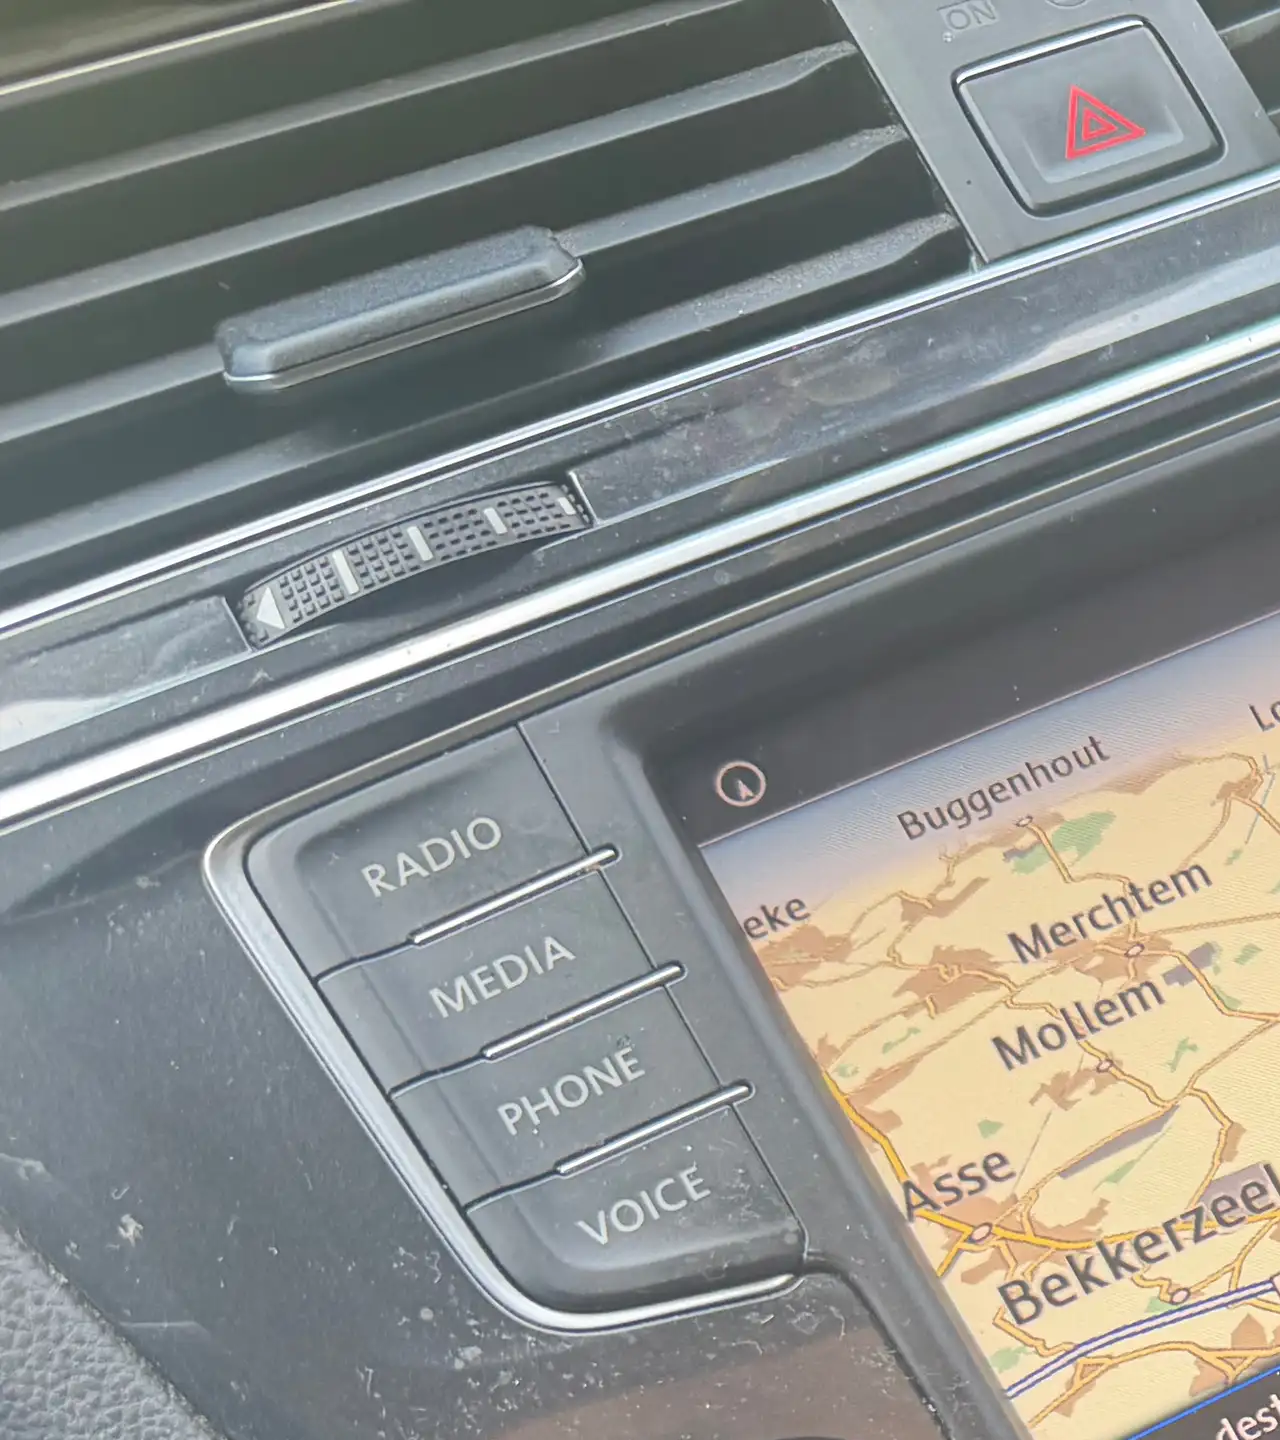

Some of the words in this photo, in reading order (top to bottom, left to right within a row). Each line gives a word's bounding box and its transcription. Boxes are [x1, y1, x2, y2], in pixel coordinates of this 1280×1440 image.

[945, 1, 996, 30] ON
[897, 736, 1111, 841] Buggenhout
[360, 815, 503, 898] RADIO
[742, 897, 811, 942] eke
[1006, 862, 1213, 965] Merchtem
[428, 933, 577, 1019] MEDIA
[990, 978, 1167, 1073] Mollem
[495, 1046, 646, 1137] PHONE
[574, 1164, 712, 1247] VOICE
[901, 1148, 1018, 1224] Asse
